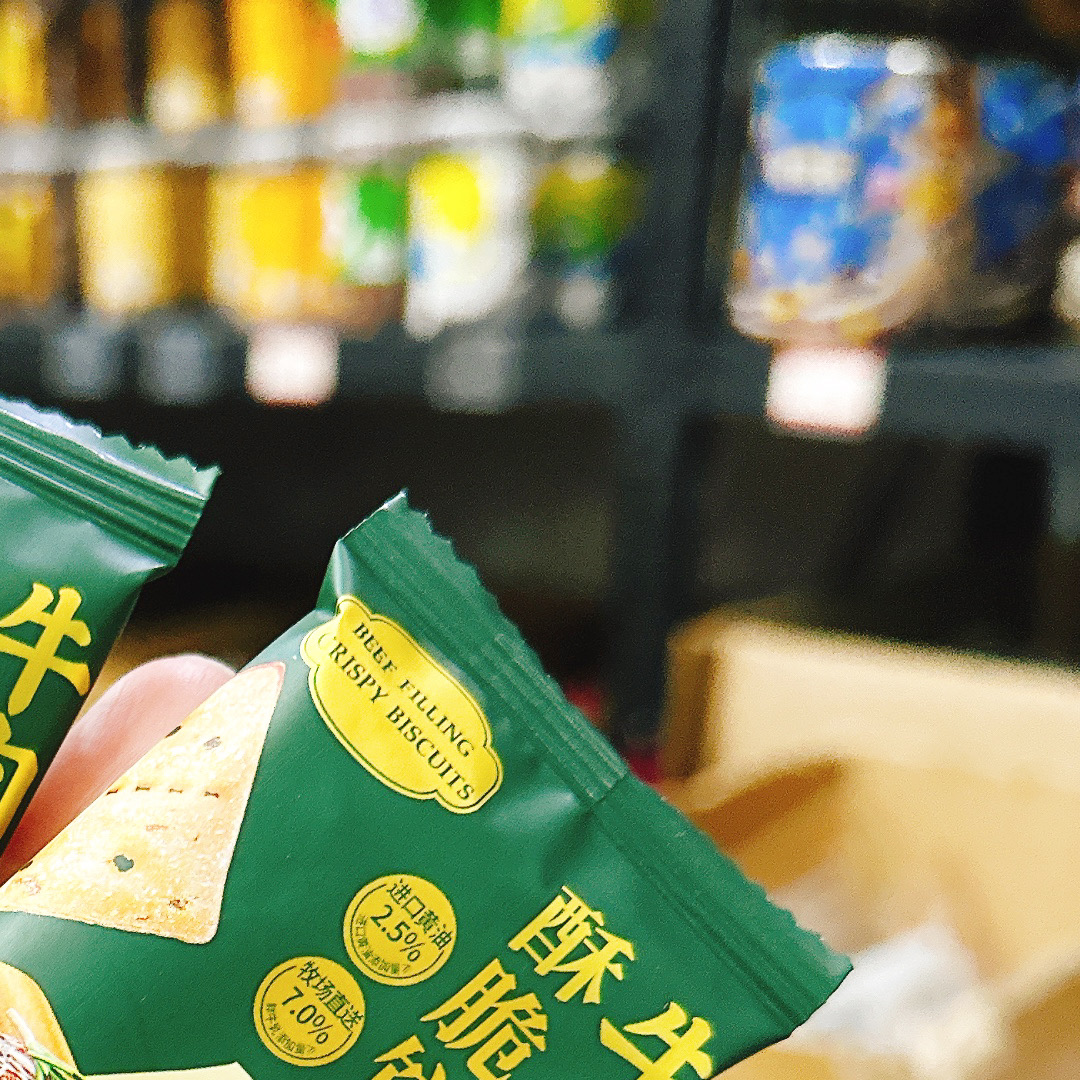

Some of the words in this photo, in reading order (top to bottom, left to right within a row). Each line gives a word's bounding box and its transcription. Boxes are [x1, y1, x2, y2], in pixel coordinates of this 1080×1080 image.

[353, 621, 398, 673] BEEF
[399, 678, 475, 758] FILLING
[385, 705, 475, 801] BISCUITS
[370, 903, 426, 962] 2.5%
[386, 877, 453, 951] 进口黄油
[281, 985, 334, 1045] 7.0%
[297, 960, 365, 1031] 牧场直送
